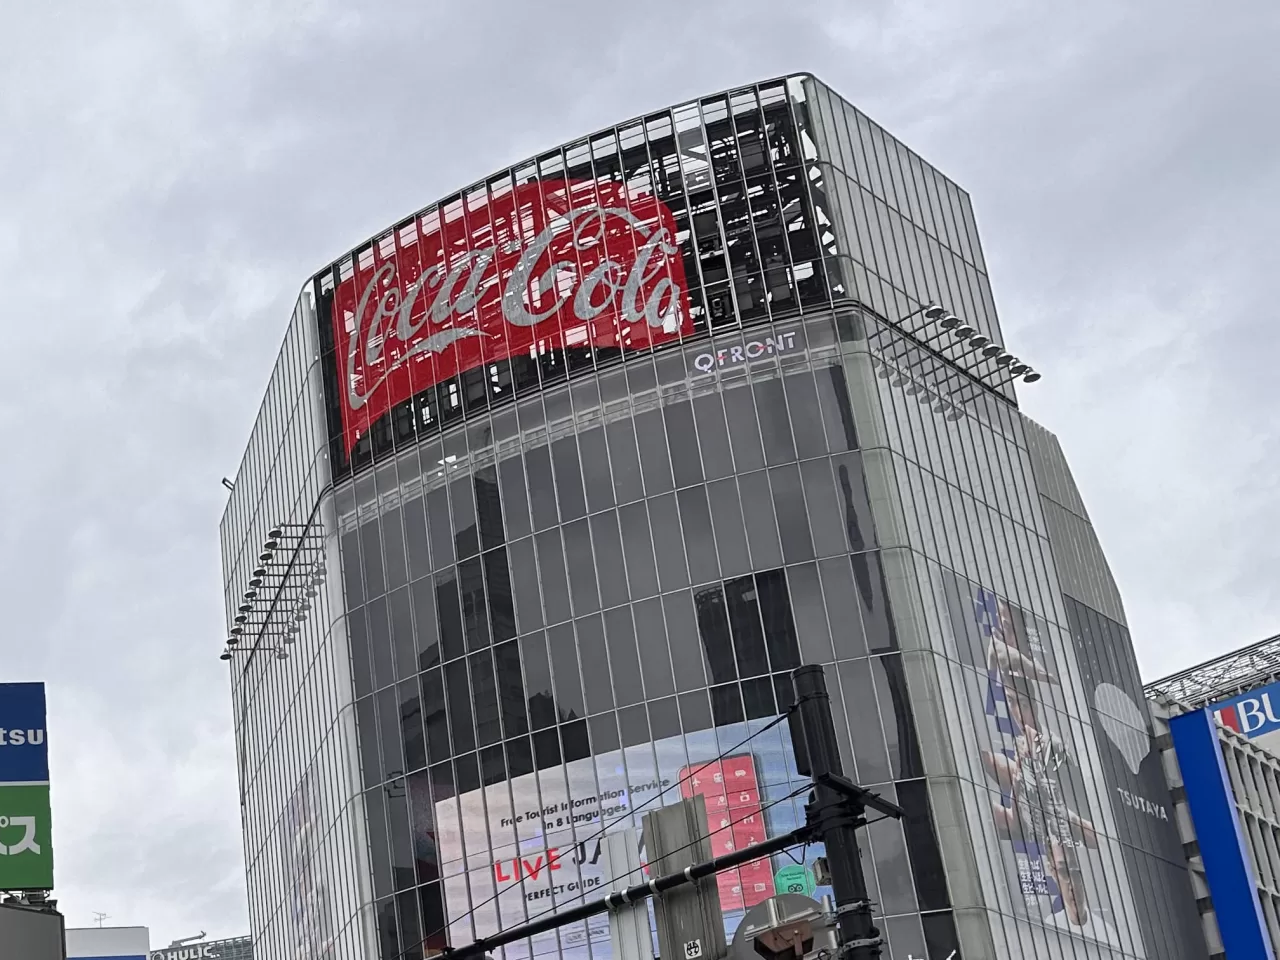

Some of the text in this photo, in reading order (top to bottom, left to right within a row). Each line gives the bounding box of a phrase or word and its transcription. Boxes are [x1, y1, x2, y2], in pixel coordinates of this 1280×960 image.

[693, 331, 796, 373] QFRONT
[500, 777, 671, 829] Free Tourist Information Service
[556, 816, 564, 828] 8
[566, 802, 628, 826] Languages
[1117, 787, 1169, 823] TSUTAYA
[495, 848, 562, 884] LIVE
